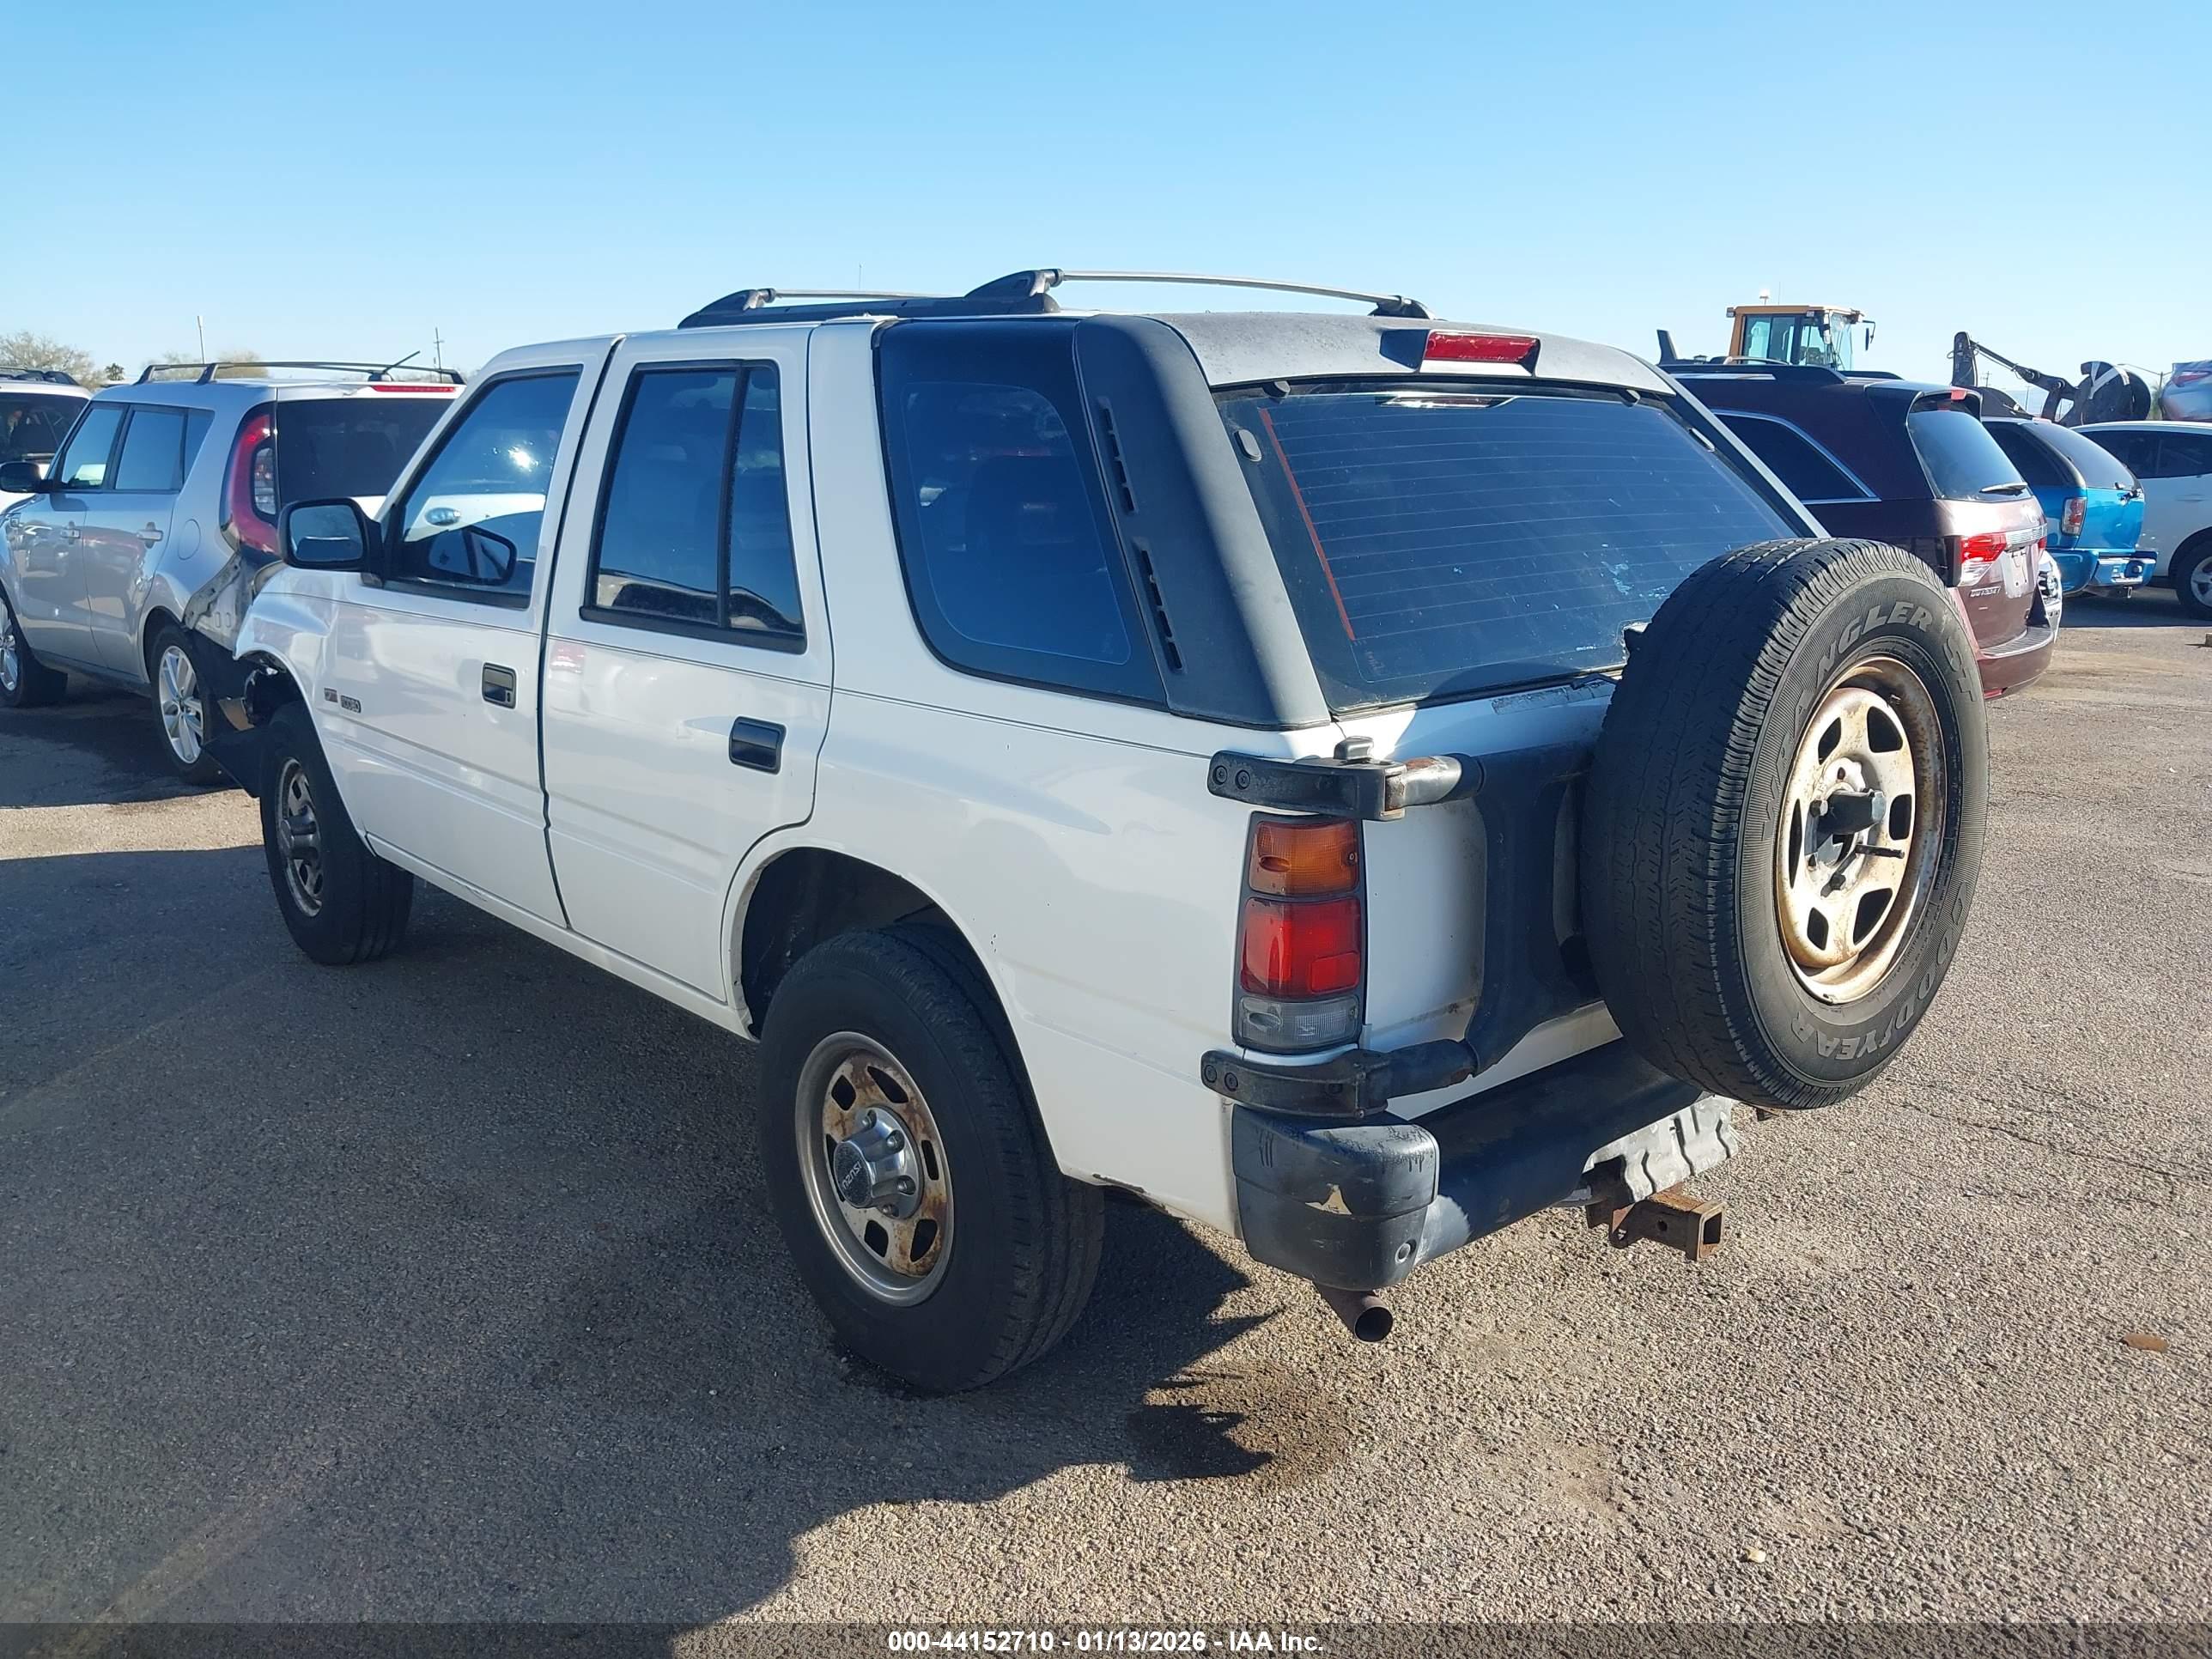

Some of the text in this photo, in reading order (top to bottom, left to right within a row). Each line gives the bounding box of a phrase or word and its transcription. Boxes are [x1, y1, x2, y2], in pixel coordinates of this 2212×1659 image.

[1760, 600, 1977, 842] WRANGLER ST
[1790, 881, 1968, 1060] GOODYEAR
